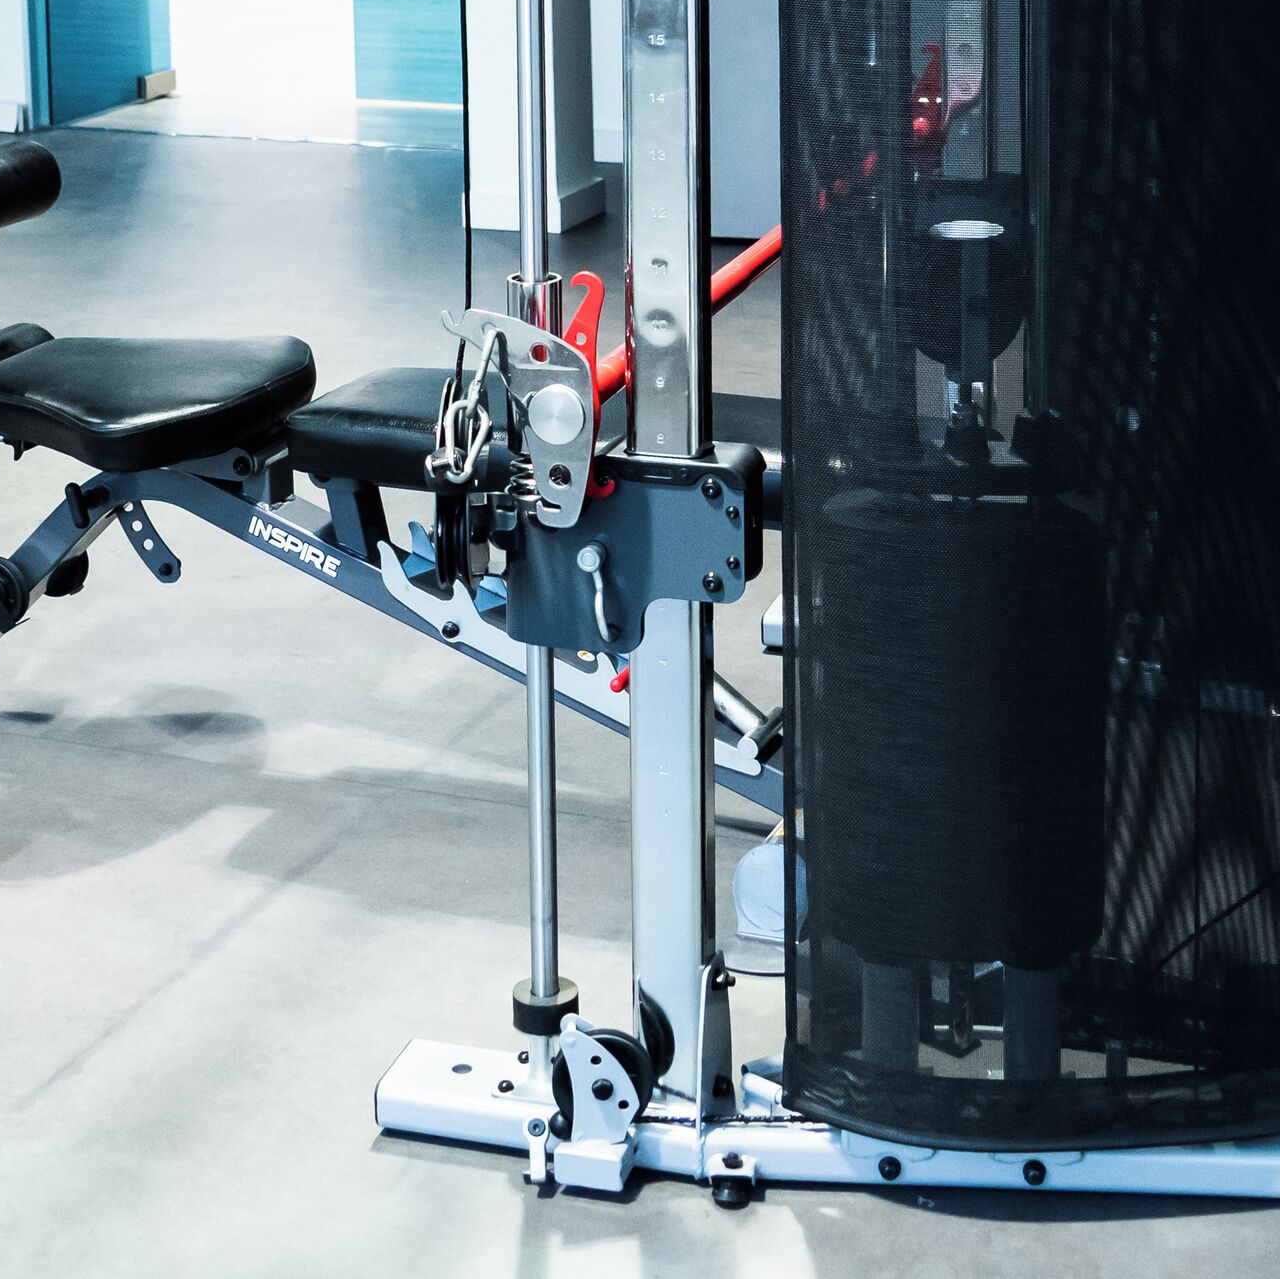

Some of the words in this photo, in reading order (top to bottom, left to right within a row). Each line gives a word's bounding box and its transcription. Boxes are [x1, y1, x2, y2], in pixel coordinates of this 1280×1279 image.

[648, 34, 665, 46] 15
[649, 92, 665, 104] 14
[649, 149, 666, 161] 13
[648, 207, 667, 218] 12
[656, 433, 665, 444] 8
[248, 516, 341, 578] INSPIRE
